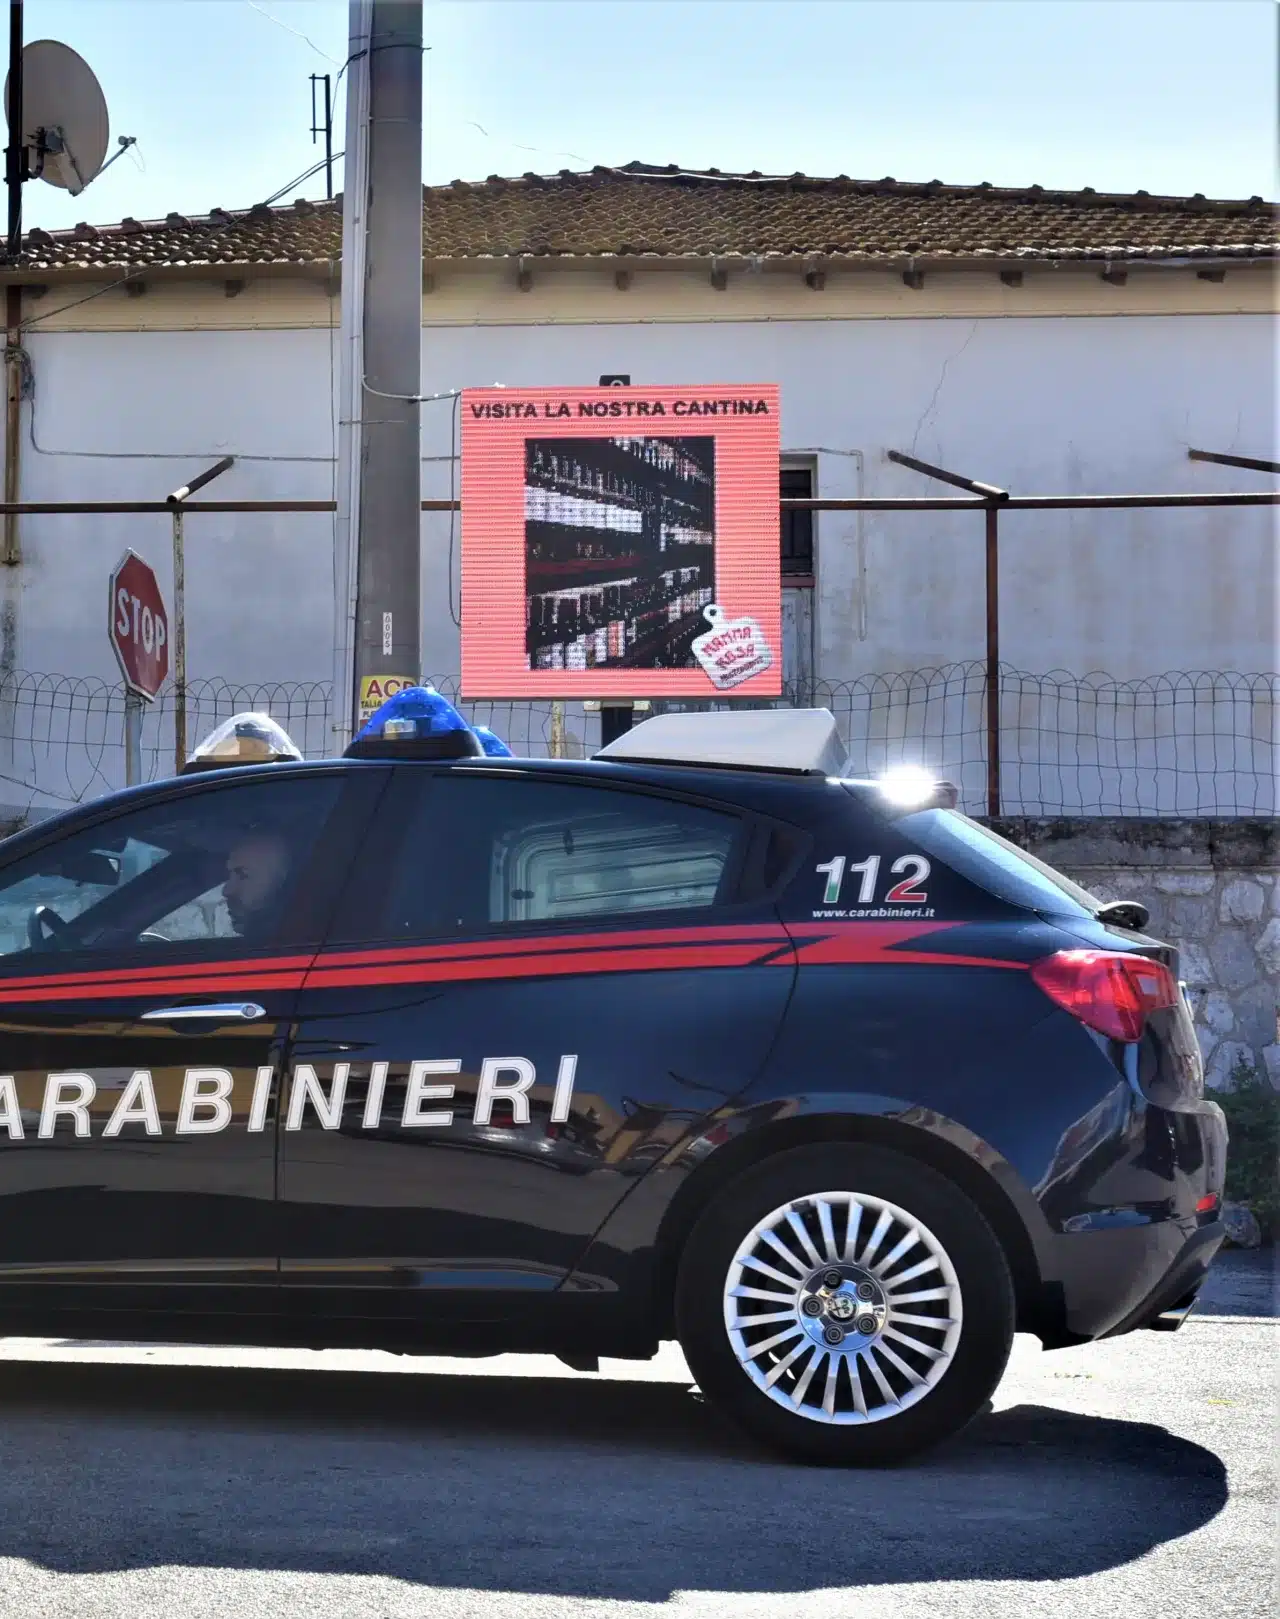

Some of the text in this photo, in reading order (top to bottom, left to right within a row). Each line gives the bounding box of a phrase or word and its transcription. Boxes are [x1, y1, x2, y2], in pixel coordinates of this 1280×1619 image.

[472, 399, 769, 419] VISITA LA NOSTRA CANTINA
[117, 587, 166, 662] STOP
[816, 854, 931, 903] 112
[812, 908, 935, 917] www.carabinieri.it
